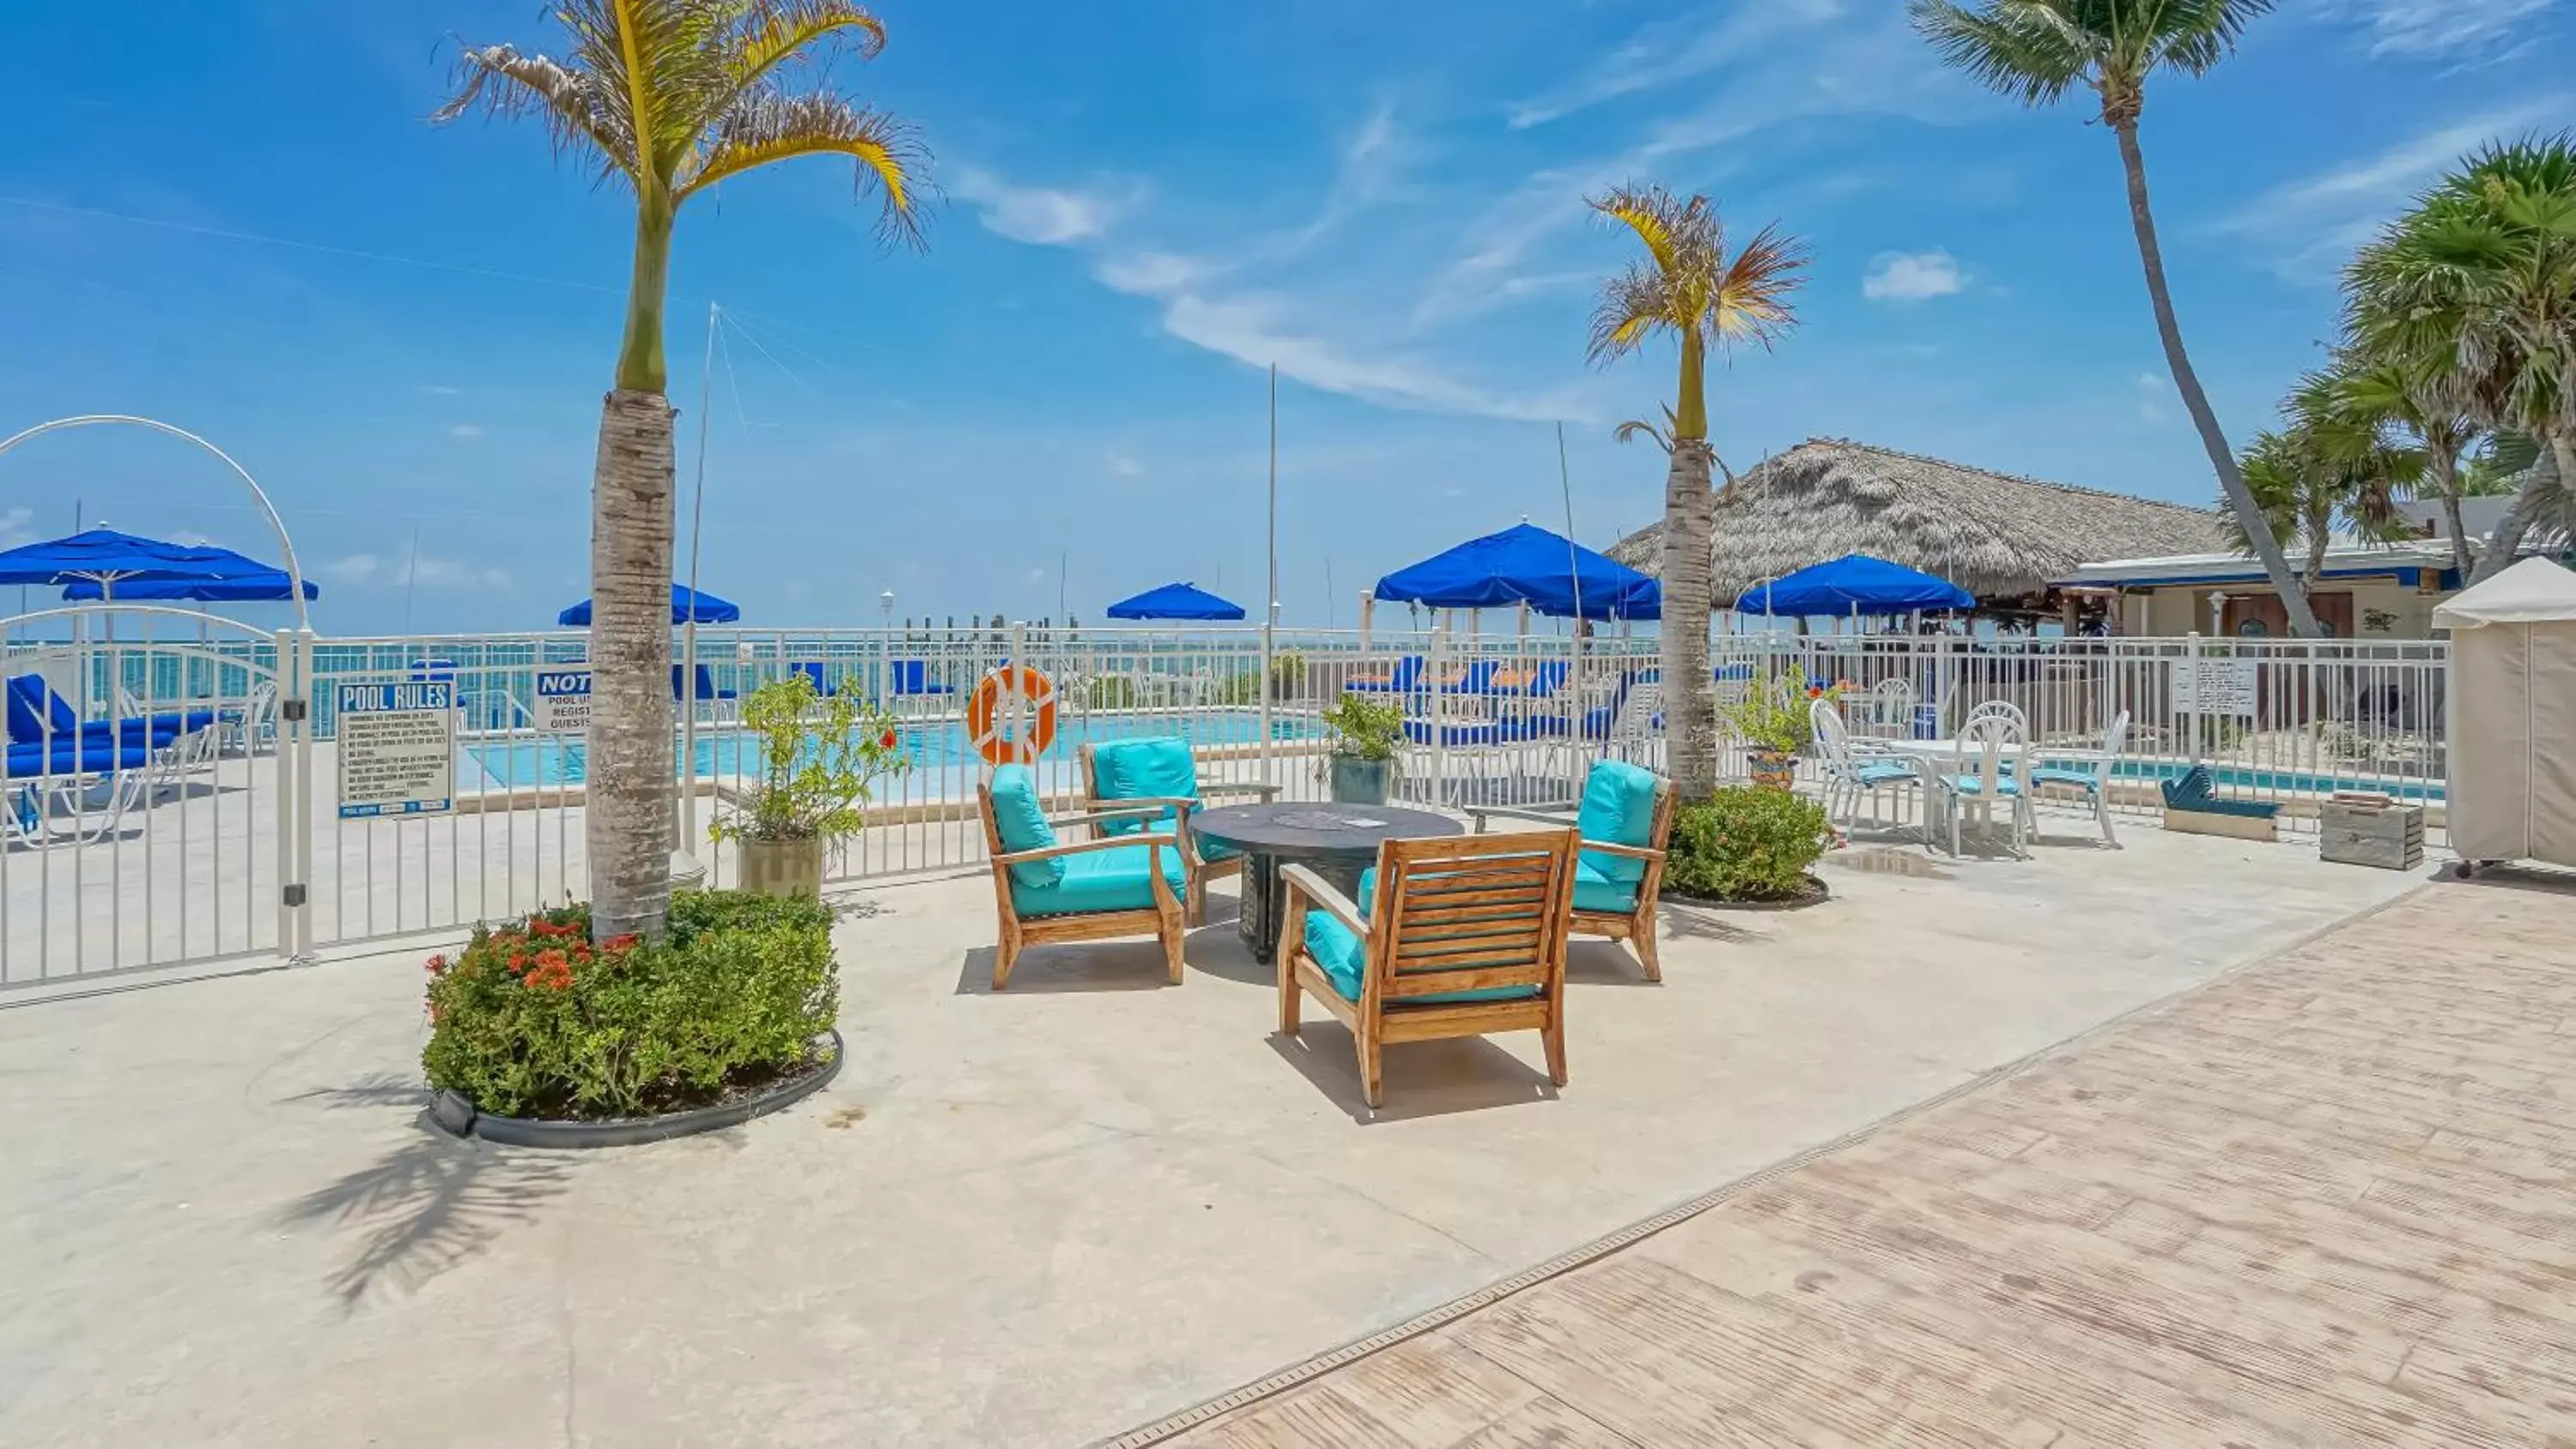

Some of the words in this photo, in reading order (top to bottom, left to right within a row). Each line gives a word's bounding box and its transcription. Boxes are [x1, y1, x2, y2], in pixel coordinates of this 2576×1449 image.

[542, 675, 591, 693] NOT
[343, 686, 389, 712] POOL
[395, 684, 447, 709] RULES
[549, 696, 577, 705] POOL
